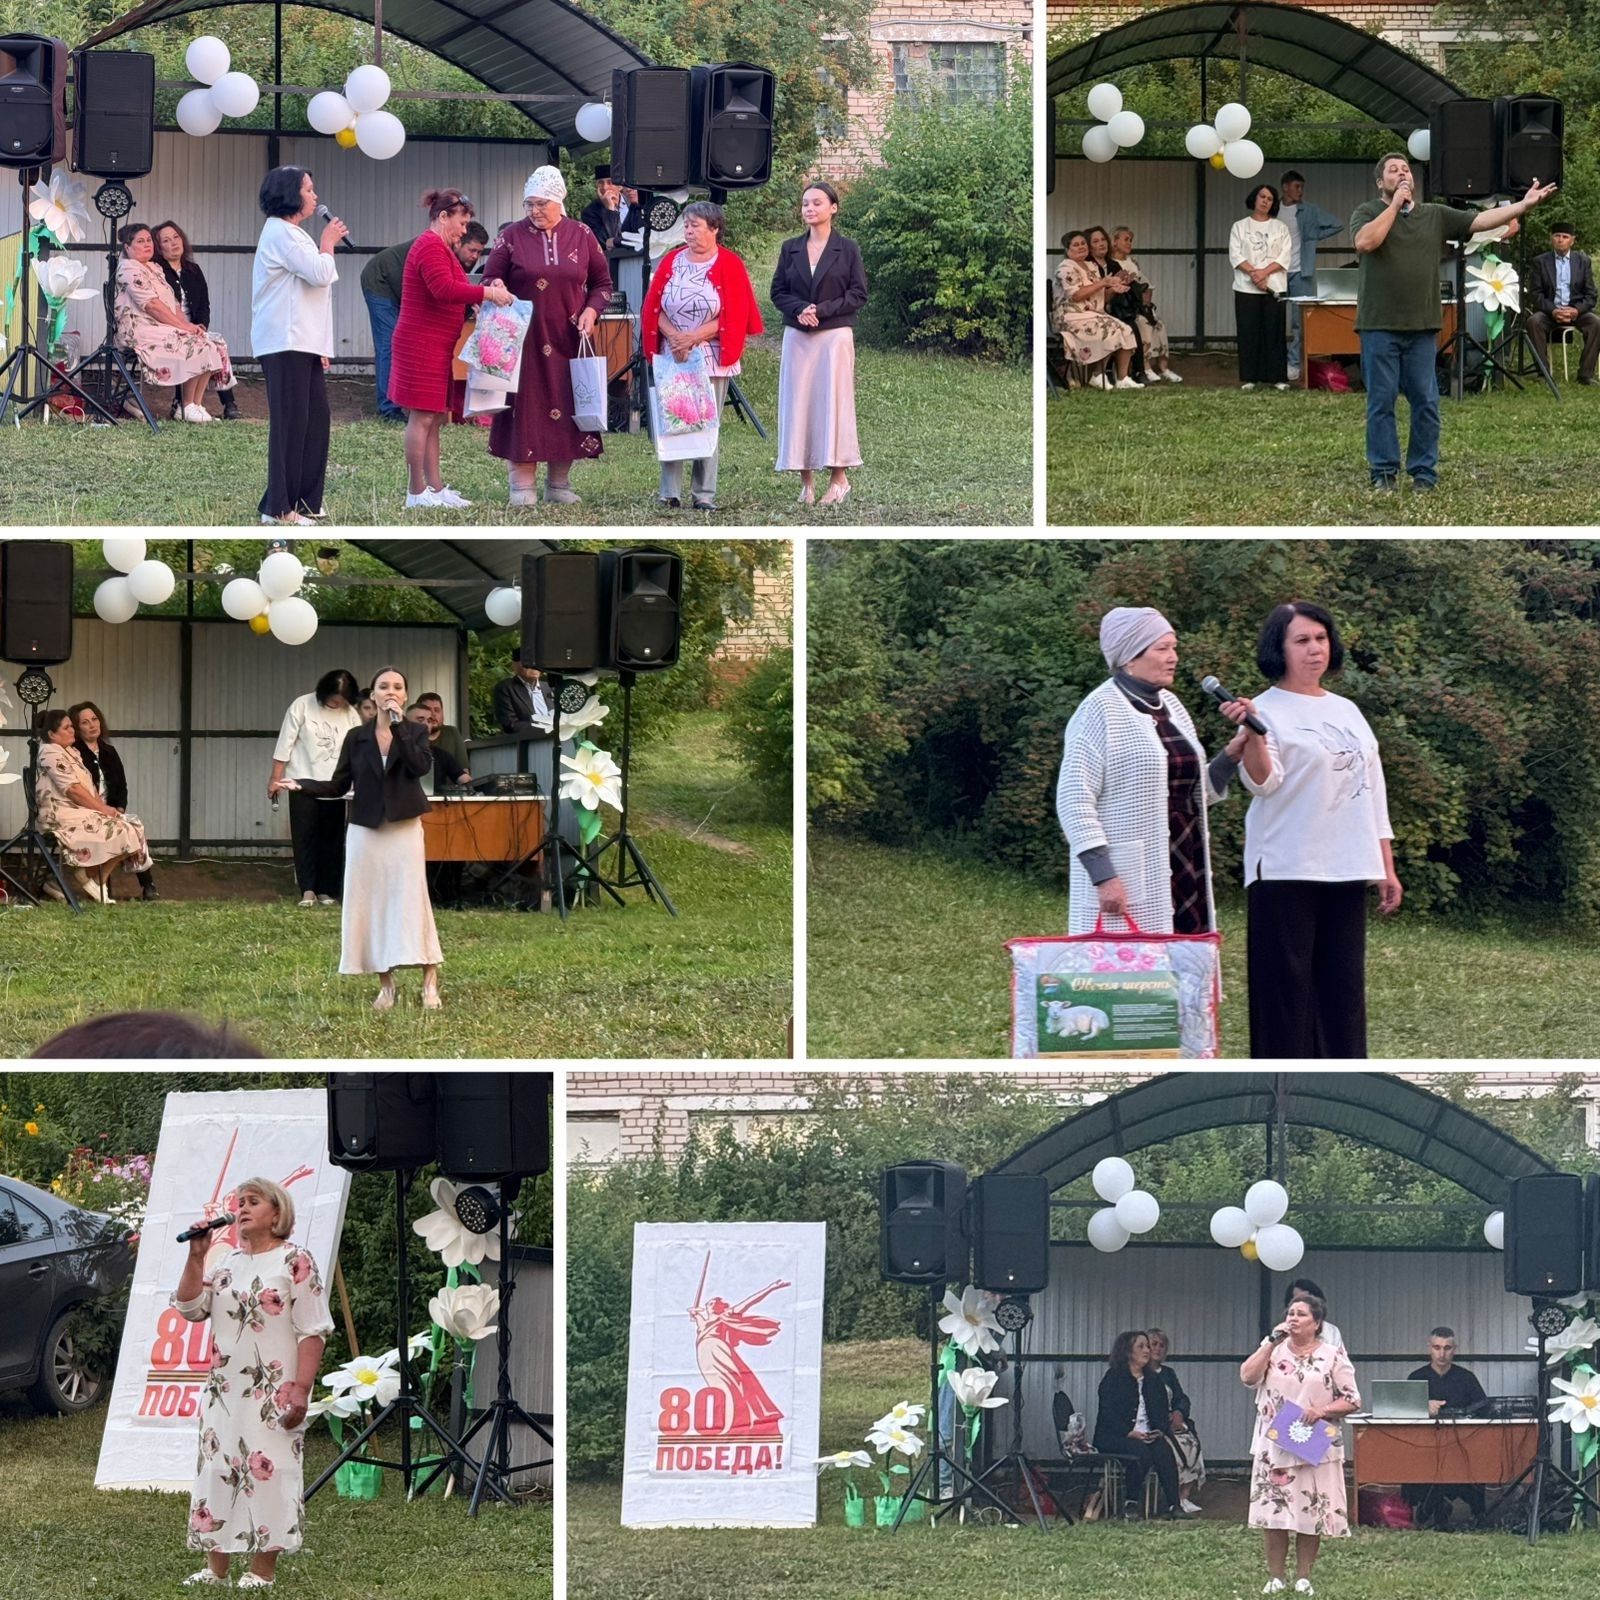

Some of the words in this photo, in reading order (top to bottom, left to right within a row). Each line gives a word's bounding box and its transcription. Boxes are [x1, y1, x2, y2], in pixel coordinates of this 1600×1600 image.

[138, 1384, 203, 1417] ПОБ
[658, 1387, 726, 1435] 80
[655, 1445, 783, 1475] ПОБЕДА!
